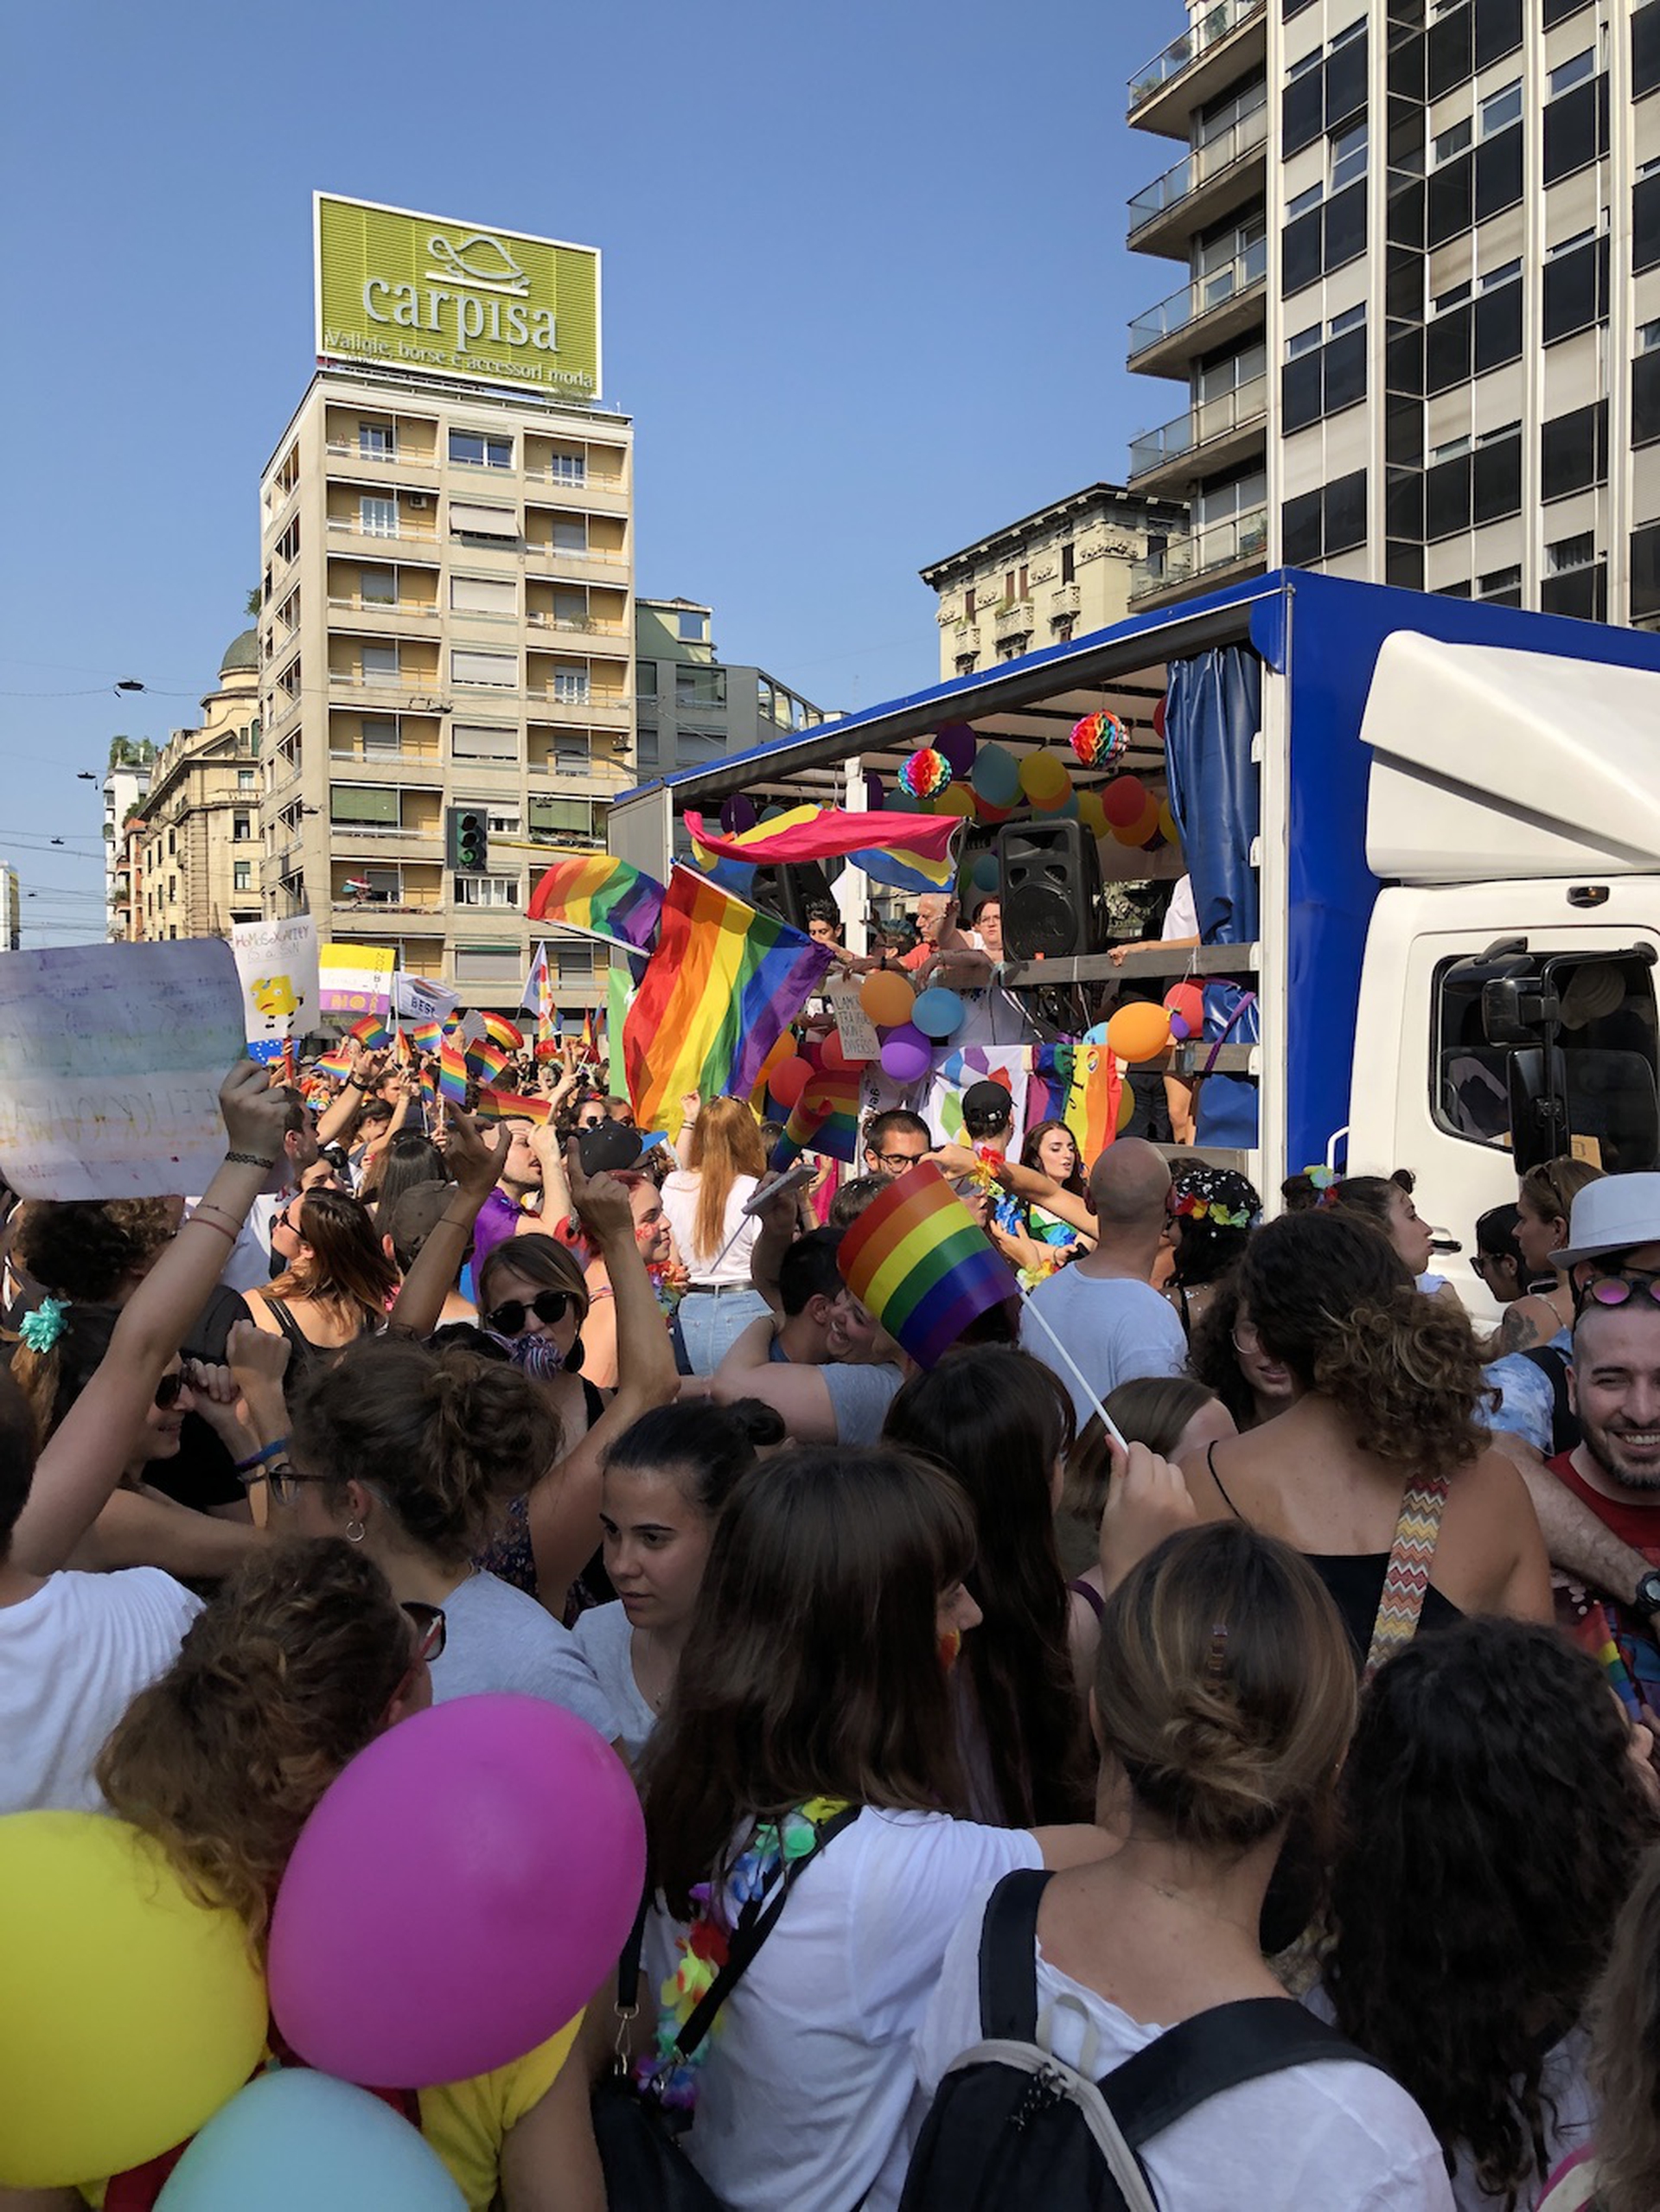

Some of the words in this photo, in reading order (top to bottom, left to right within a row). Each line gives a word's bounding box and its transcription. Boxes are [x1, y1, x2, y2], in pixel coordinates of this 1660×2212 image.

[362, 277, 559, 352] carpisa
[398, 341, 445, 363] borse
[451, 353, 463, 367] e
[467, 355, 543, 379] accessori
[548, 370, 593, 387] moda
